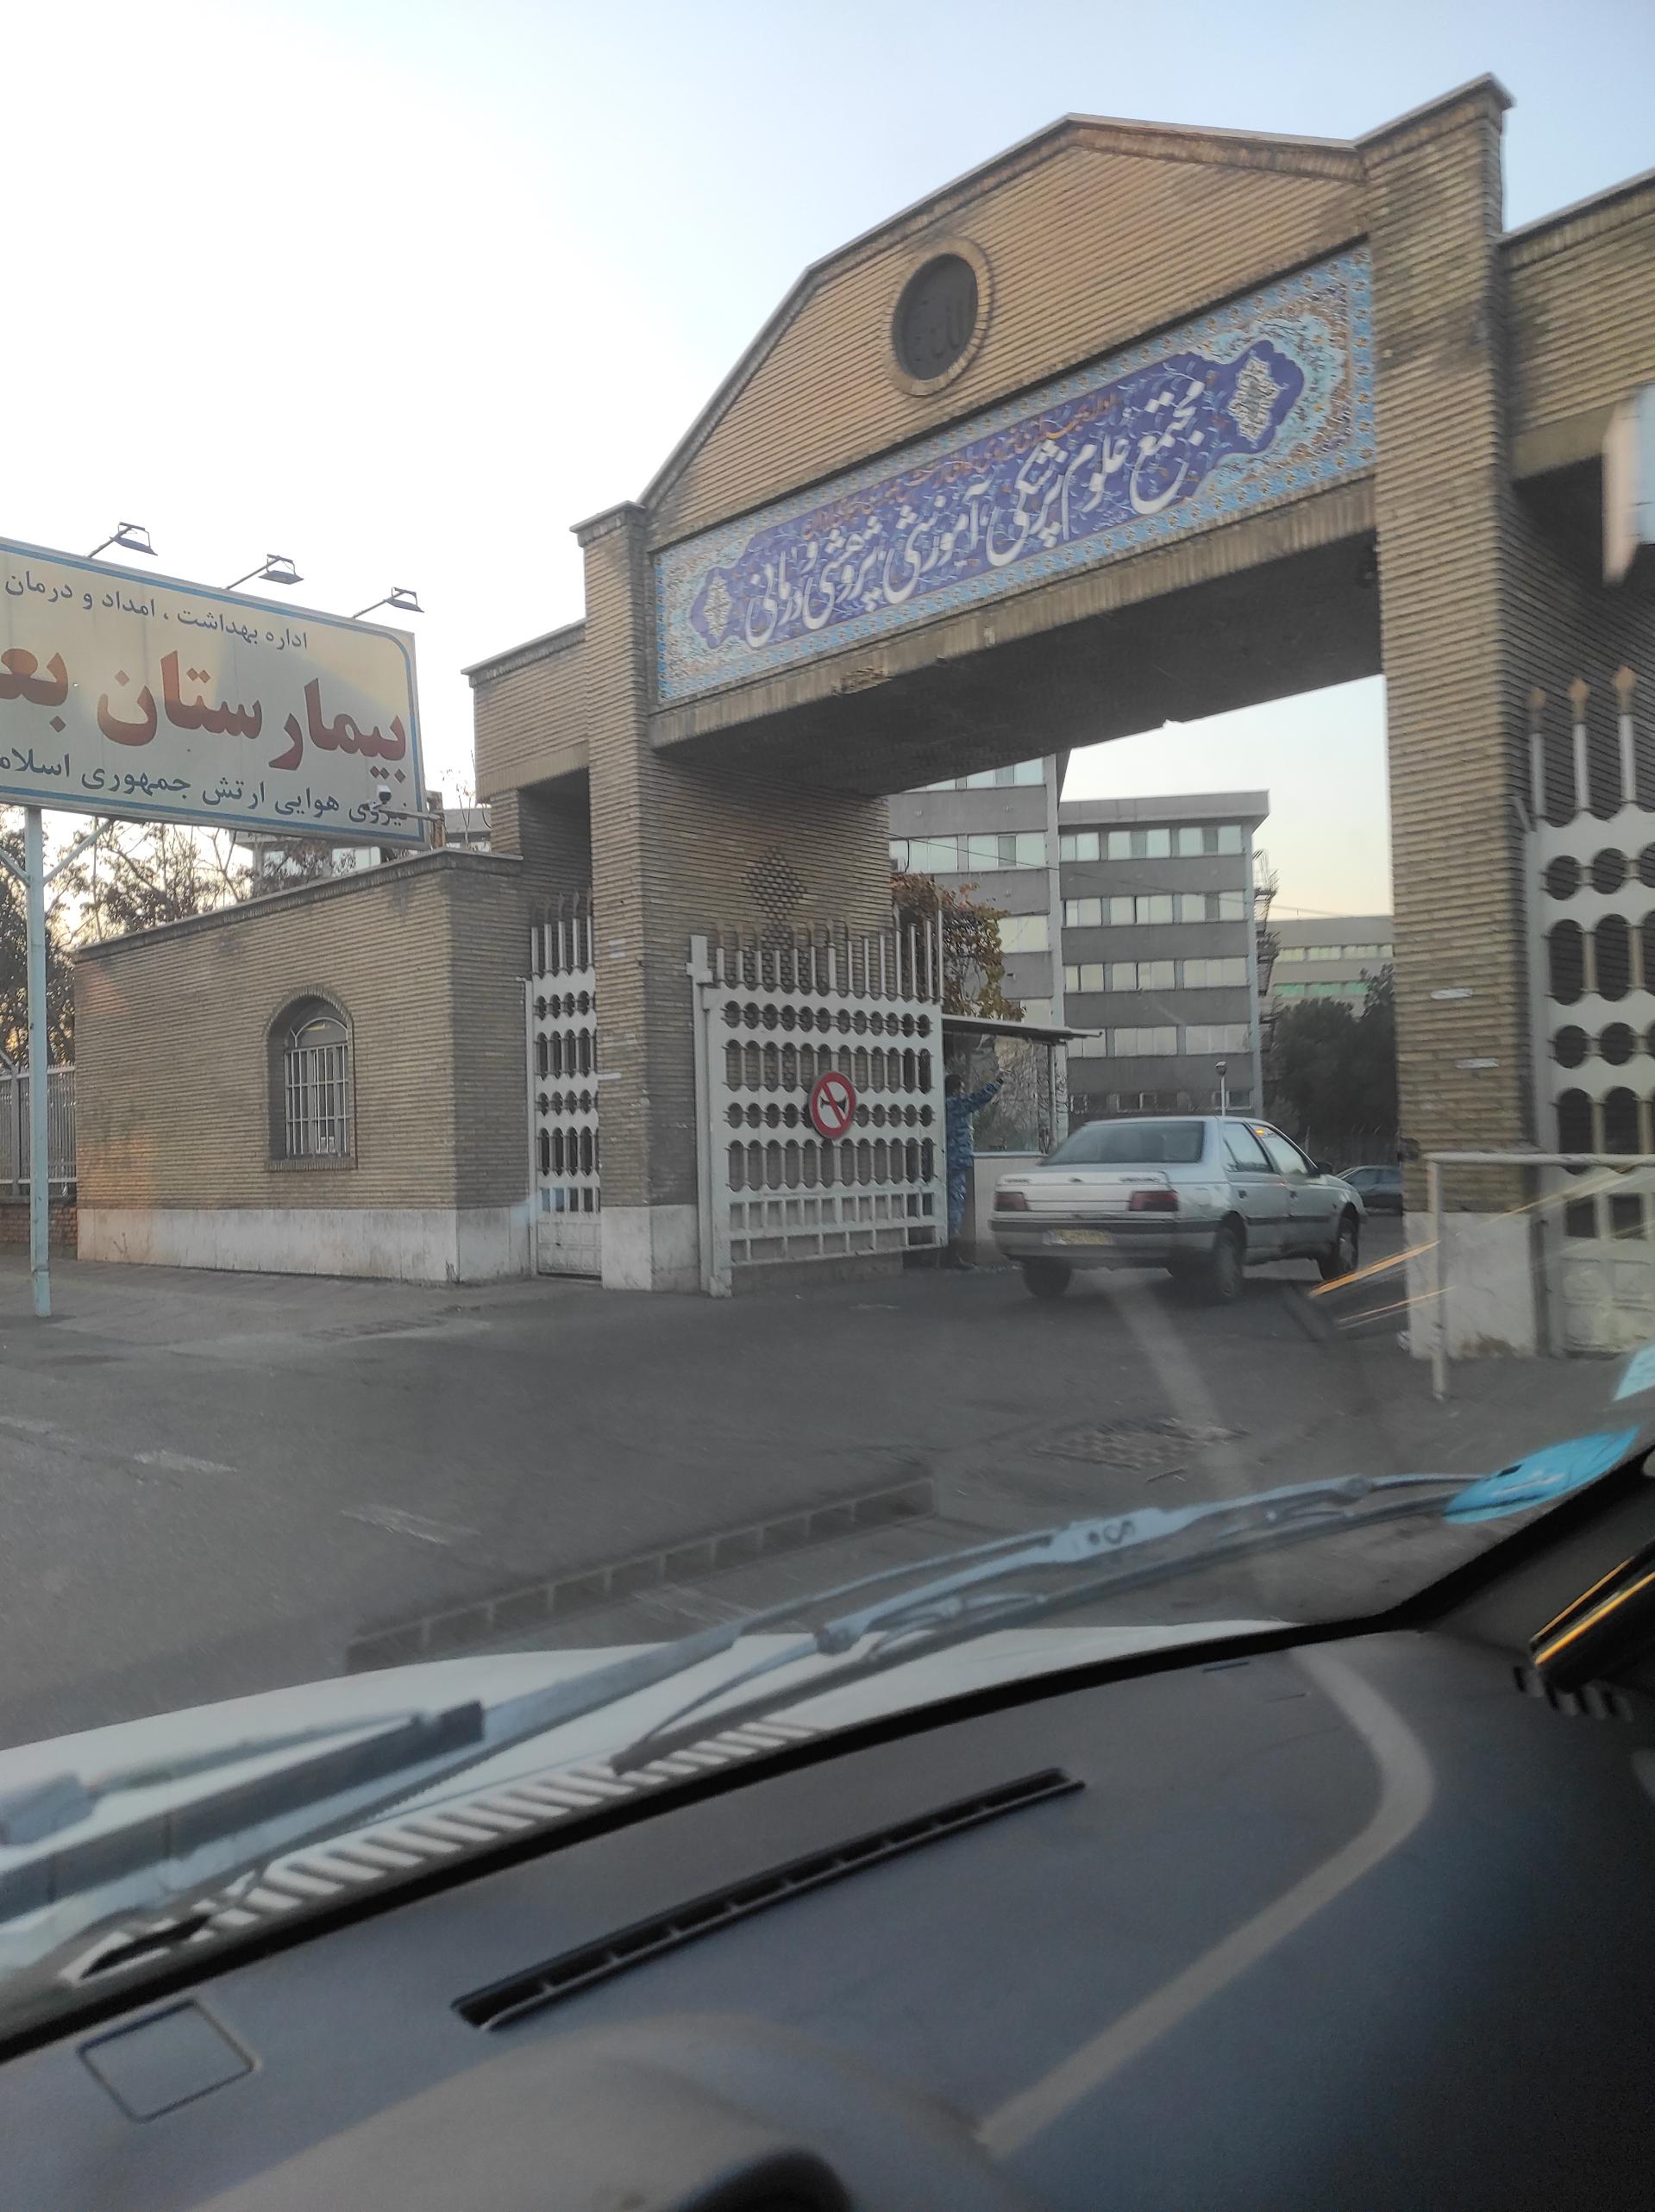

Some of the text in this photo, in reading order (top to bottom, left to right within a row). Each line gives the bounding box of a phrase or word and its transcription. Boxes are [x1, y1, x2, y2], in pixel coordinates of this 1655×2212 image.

[1130, 380, 1206, 515] مجتمع
[1061, 433, 1132, 542] علوم
[5, 570, 72, 602] درمان
[82, 592, 93, 610] و
[102, 590, 155, 617] امداد
[266, 628, 308, 650] اداره
[97, 649, 407, 784] بیمارستان
[81, 767, 191, 800] جمهوری
[201, 776, 265, 811] ارتش
[274, 786, 340, 818] هوایی
